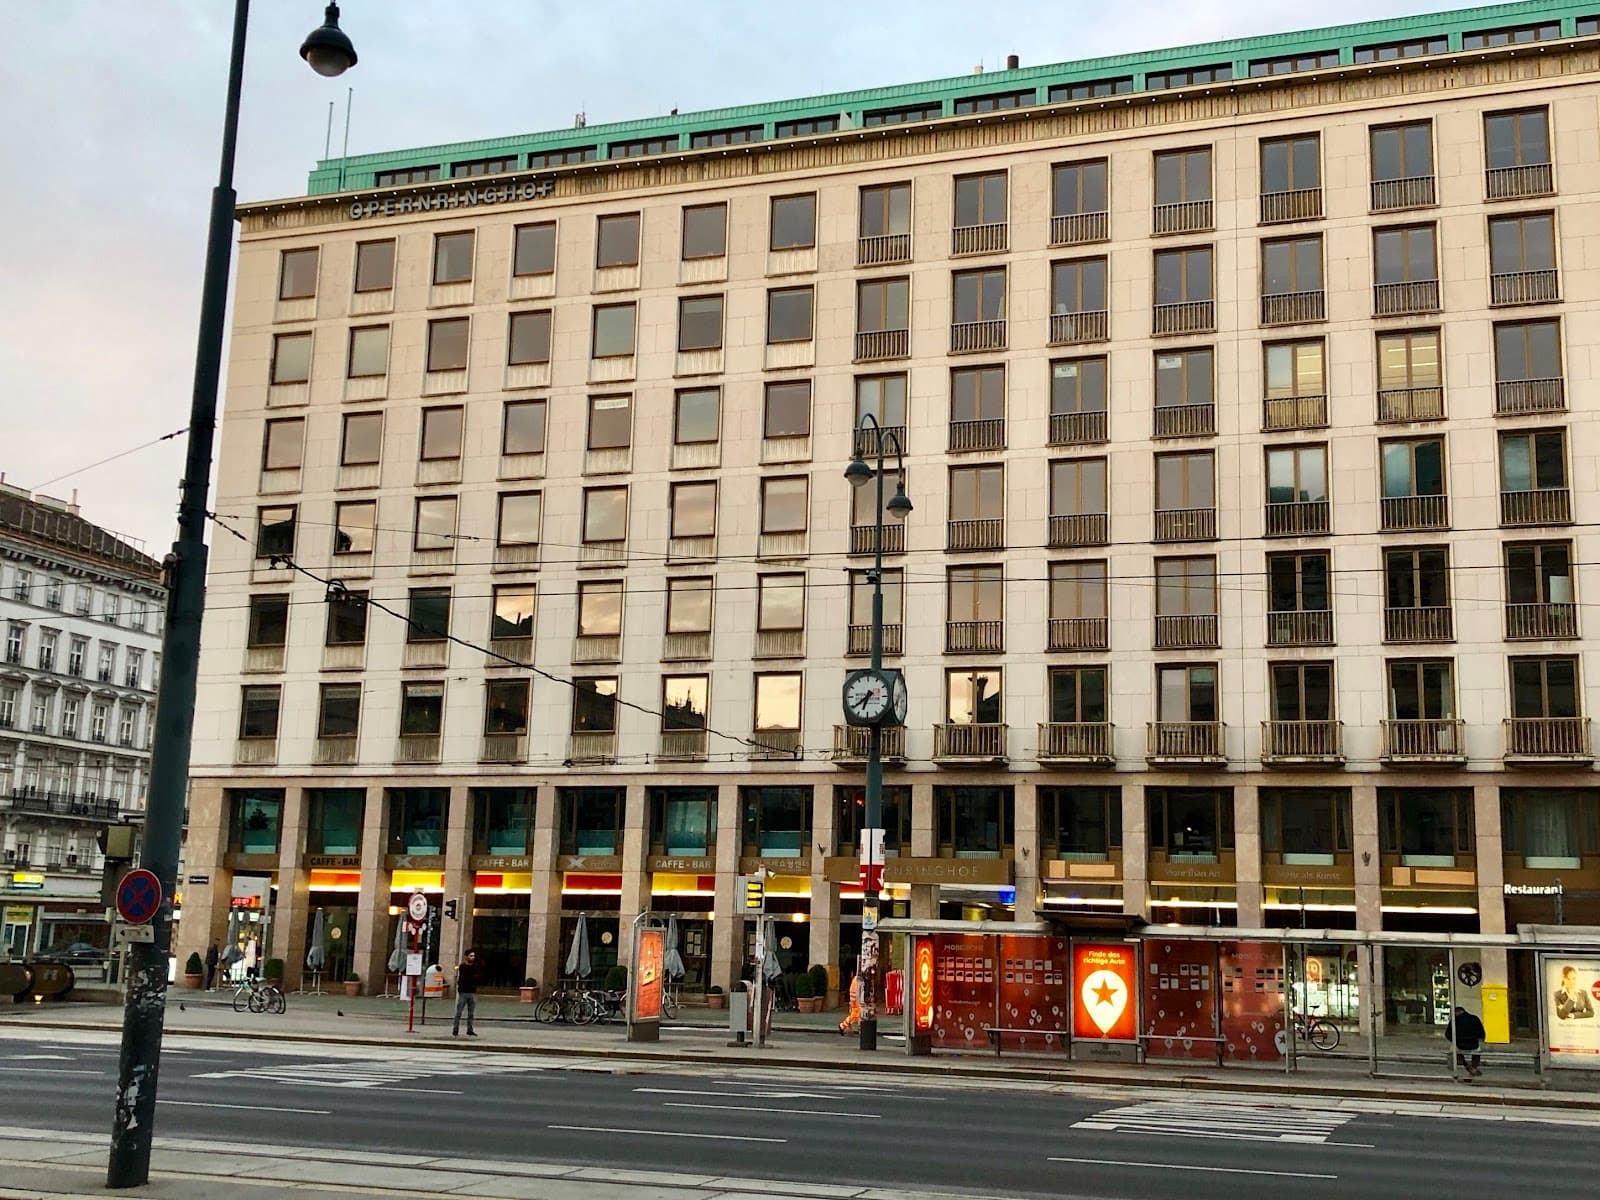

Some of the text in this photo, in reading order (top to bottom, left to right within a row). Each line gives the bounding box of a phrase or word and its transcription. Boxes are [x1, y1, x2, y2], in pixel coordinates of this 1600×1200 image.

[349, 179, 554, 219] OPERNRINGHOF
[1504, 884, 1563, 895] Restaurant
[1088, 950, 1121, 959] Finde das
[1083, 957, 1108, 966] richtige
